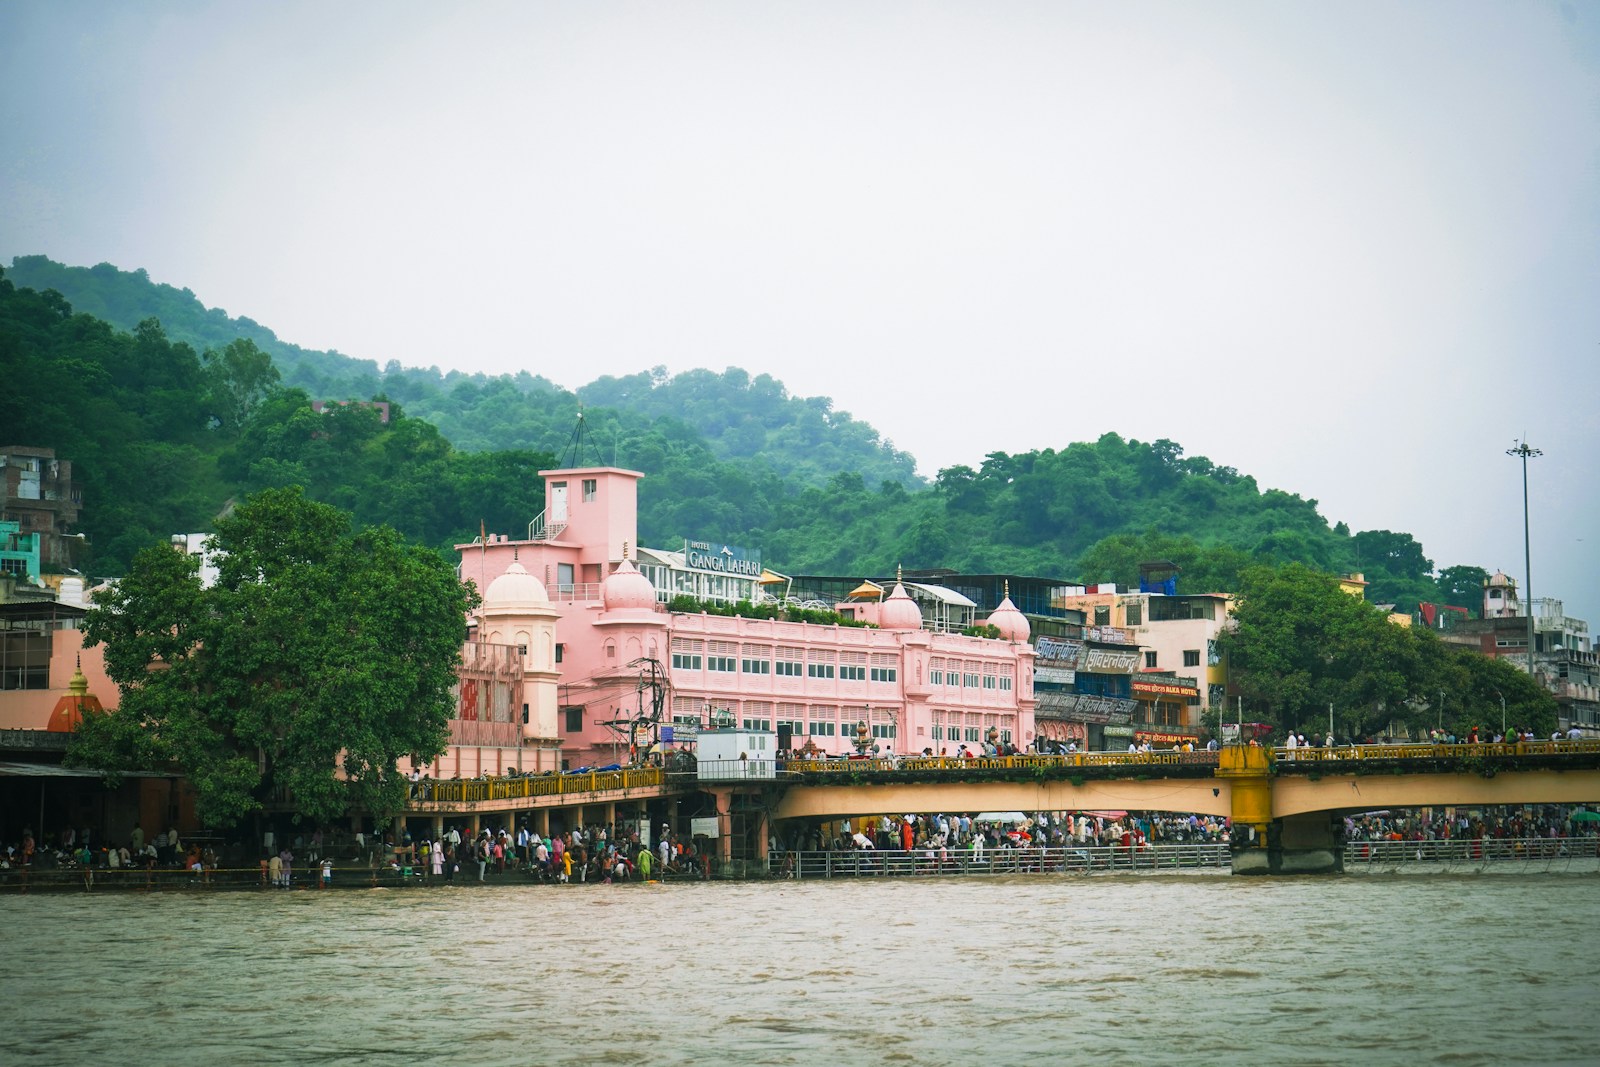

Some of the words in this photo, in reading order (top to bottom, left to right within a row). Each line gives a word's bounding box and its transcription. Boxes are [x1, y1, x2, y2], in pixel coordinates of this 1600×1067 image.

[691, 541, 710, 551] HOTEL
[690, 551, 724, 571] GANGA
[727, 556, 760, 576] LAHARI
[1151, 684, 1166, 693] होटल
[1181, 688, 1198, 696] HOTEL
[1152, 733, 1168, 742] होटल
[1167, 735, 1181, 743] ALKA
